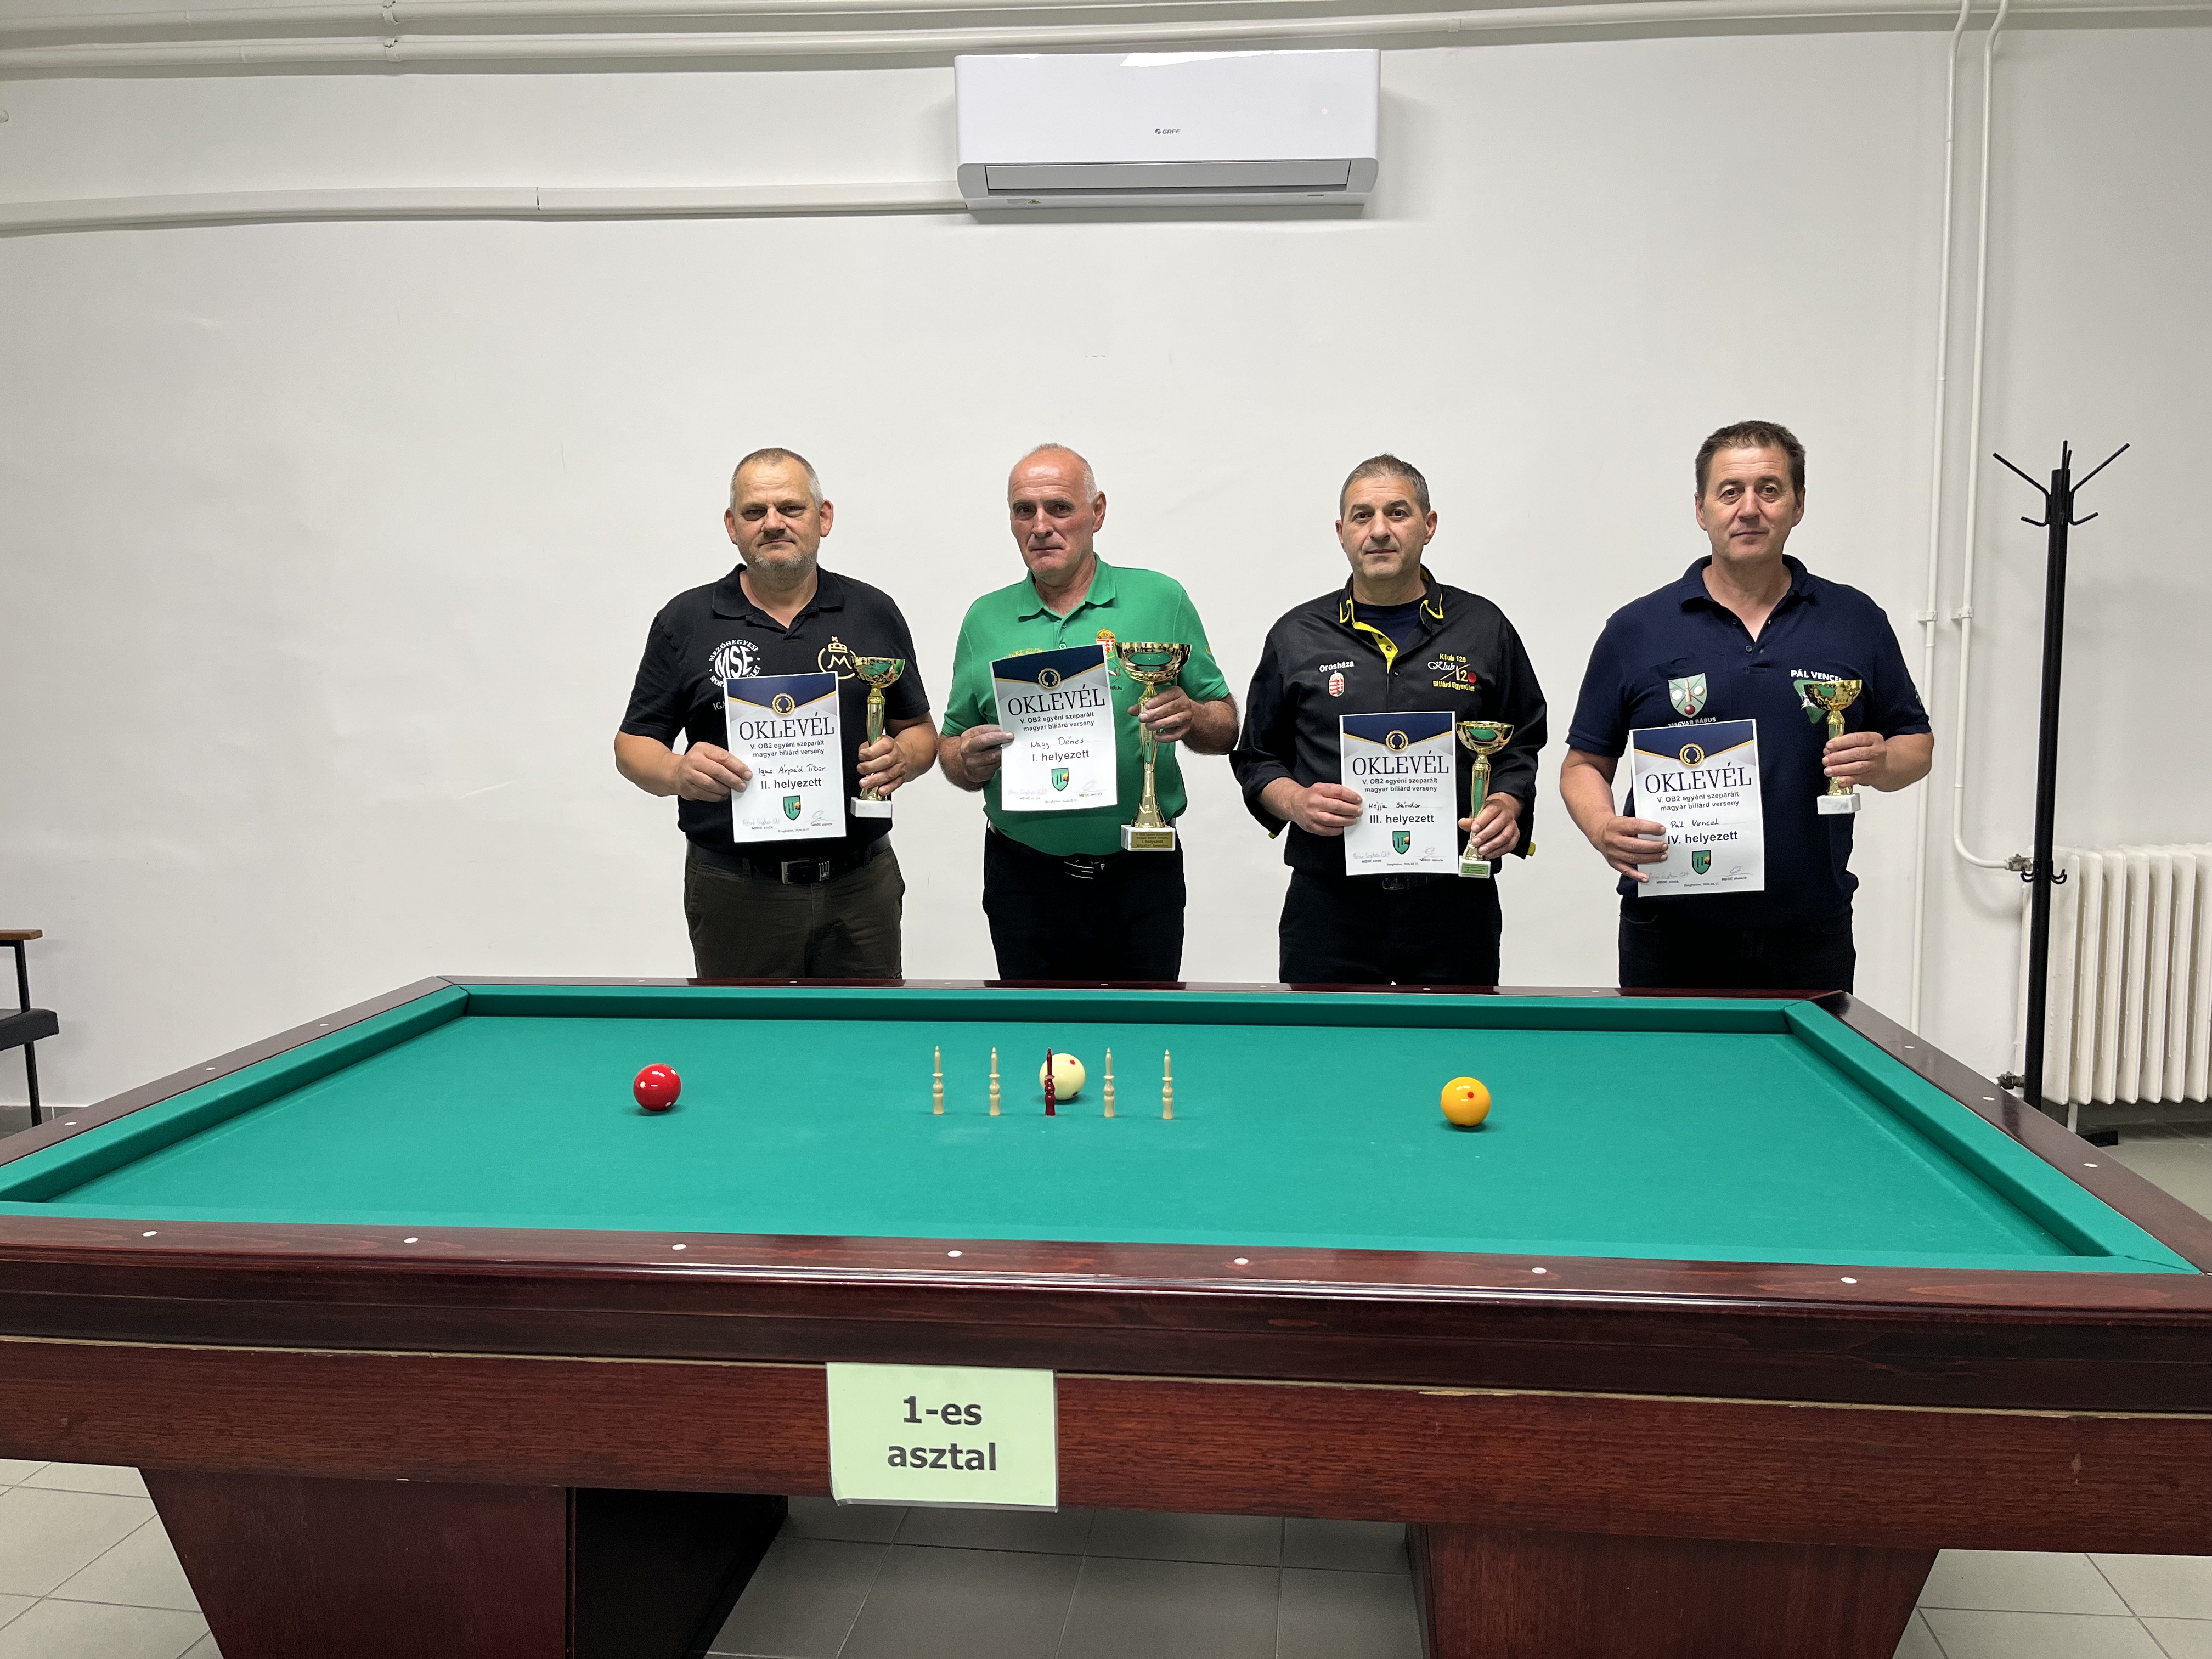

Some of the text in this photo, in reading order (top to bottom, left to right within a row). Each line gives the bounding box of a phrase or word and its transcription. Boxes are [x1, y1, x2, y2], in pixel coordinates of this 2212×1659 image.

[715, 645, 753, 679] MSE
[1440, 653, 1455, 661] Klub
[1319, 661, 1355, 673] Orosháza
[1427, 661, 1455, 670] Klub
[1791, 668, 1809, 678] PÁL
[1008, 684, 1105, 716] OKLEVÉL
[1043, 714, 1064, 723] egyéni
[739, 712, 834, 740] OKLEVÉL
[774, 741, 795, 749] egyéni
[1031, 736, 1084, 749] Nagy Dénes
[1032, 749, 1090, 763] I. helyezett
[1352, 749, 1449, 776] OKLEVÉL
[778, 764, 804, 775] Árpád
[806, 764, 826, 772] Tibor
[1645, 762, 1752, 793] OKLEVÉL
[761, 778, 822, 790] II. helyezett
[1682, 794, 1705, 802] egyéni
[1707, 791, 1740, 799] szeparált
[1370, 814, 1435, 825] III. helyezett
[1667, 830, 1738, 845] IV. helyezett
[903, 1395, 983, 1426] 1-es
[887, 1442, 996, 1471] asztal
